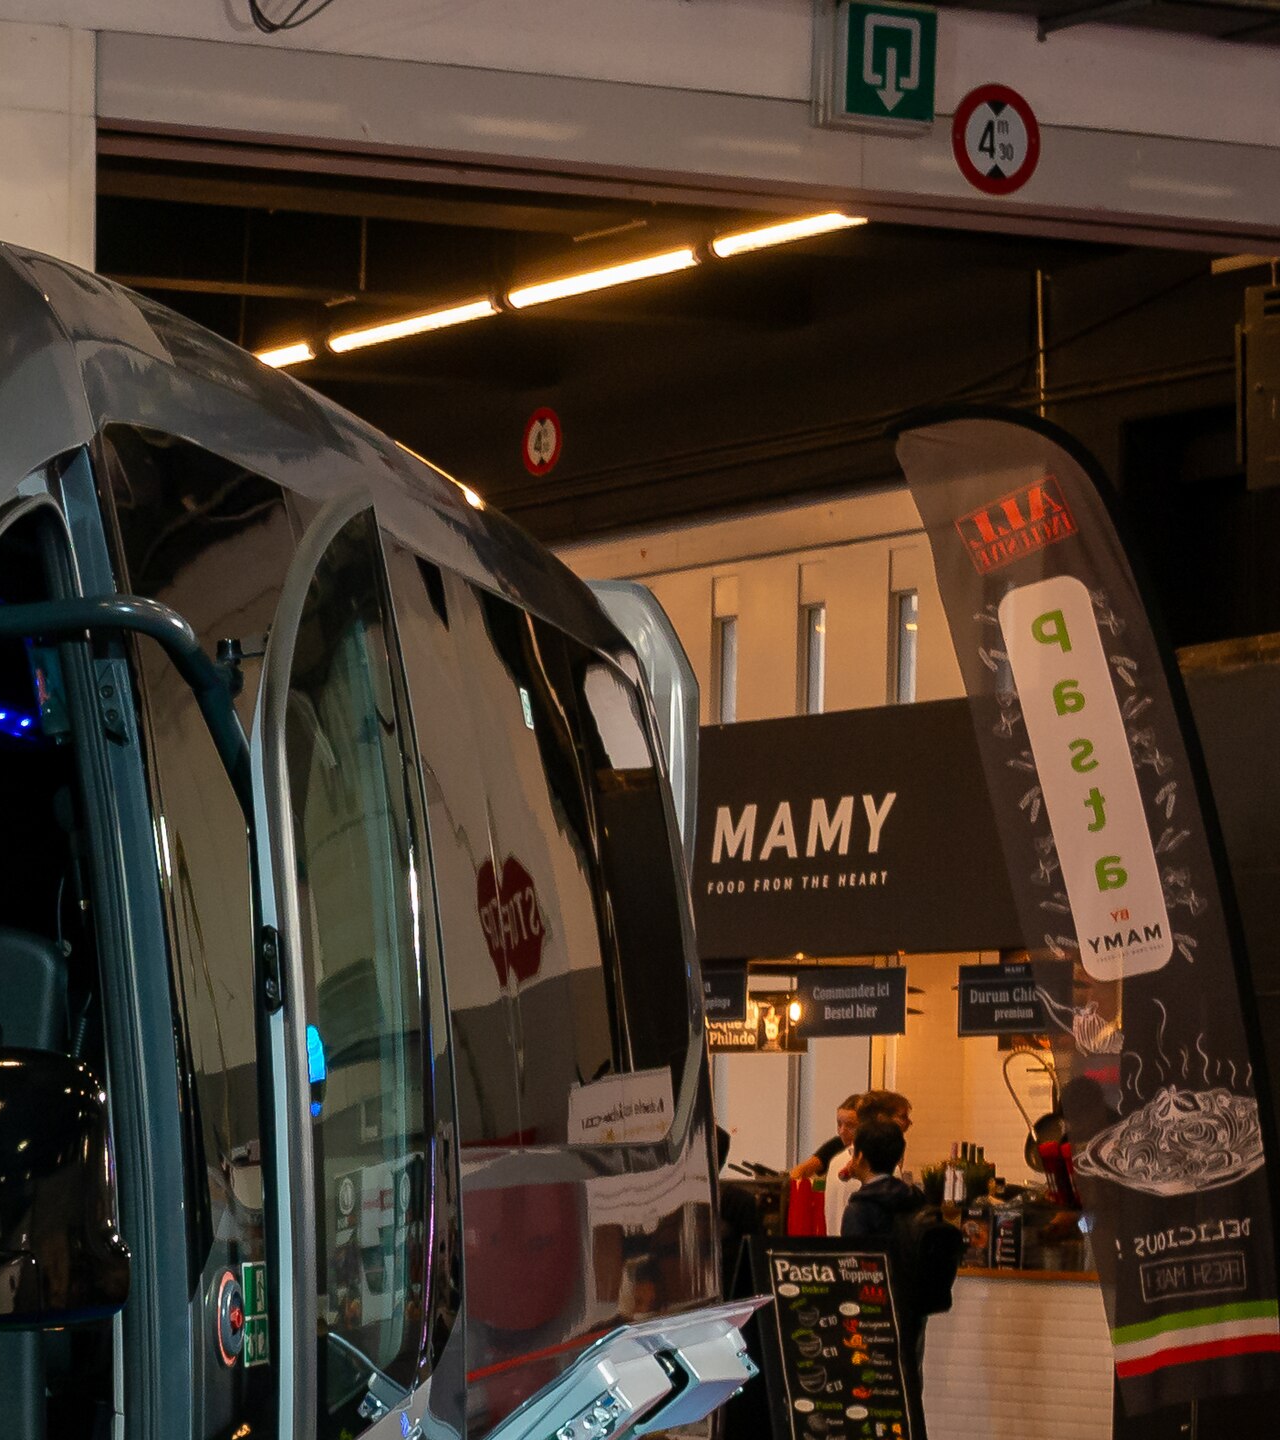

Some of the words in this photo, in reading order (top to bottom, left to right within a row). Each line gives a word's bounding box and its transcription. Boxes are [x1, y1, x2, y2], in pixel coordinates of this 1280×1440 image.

[978, 120, 995, 159] 4
[711, 792, 897, 864] MAMY
[707, 880, 745, 895] FOOD
[754, 877, 793, 893] FROM
[802, 875, 829, 889] THE
[838, 871, 888, 888] HEART
[812, 984, 875, 1001] Commandez
[970, 989, 1009, 1004] Durum
[824, 1003, 854, 1020] Bestel
[856, 1003, 878, 1019] hier
[994, 1007, 1034, 1022] premium
[775, 1259, 836, 1283] Pasta
[840, 1269, 884, 1284] Toppings
